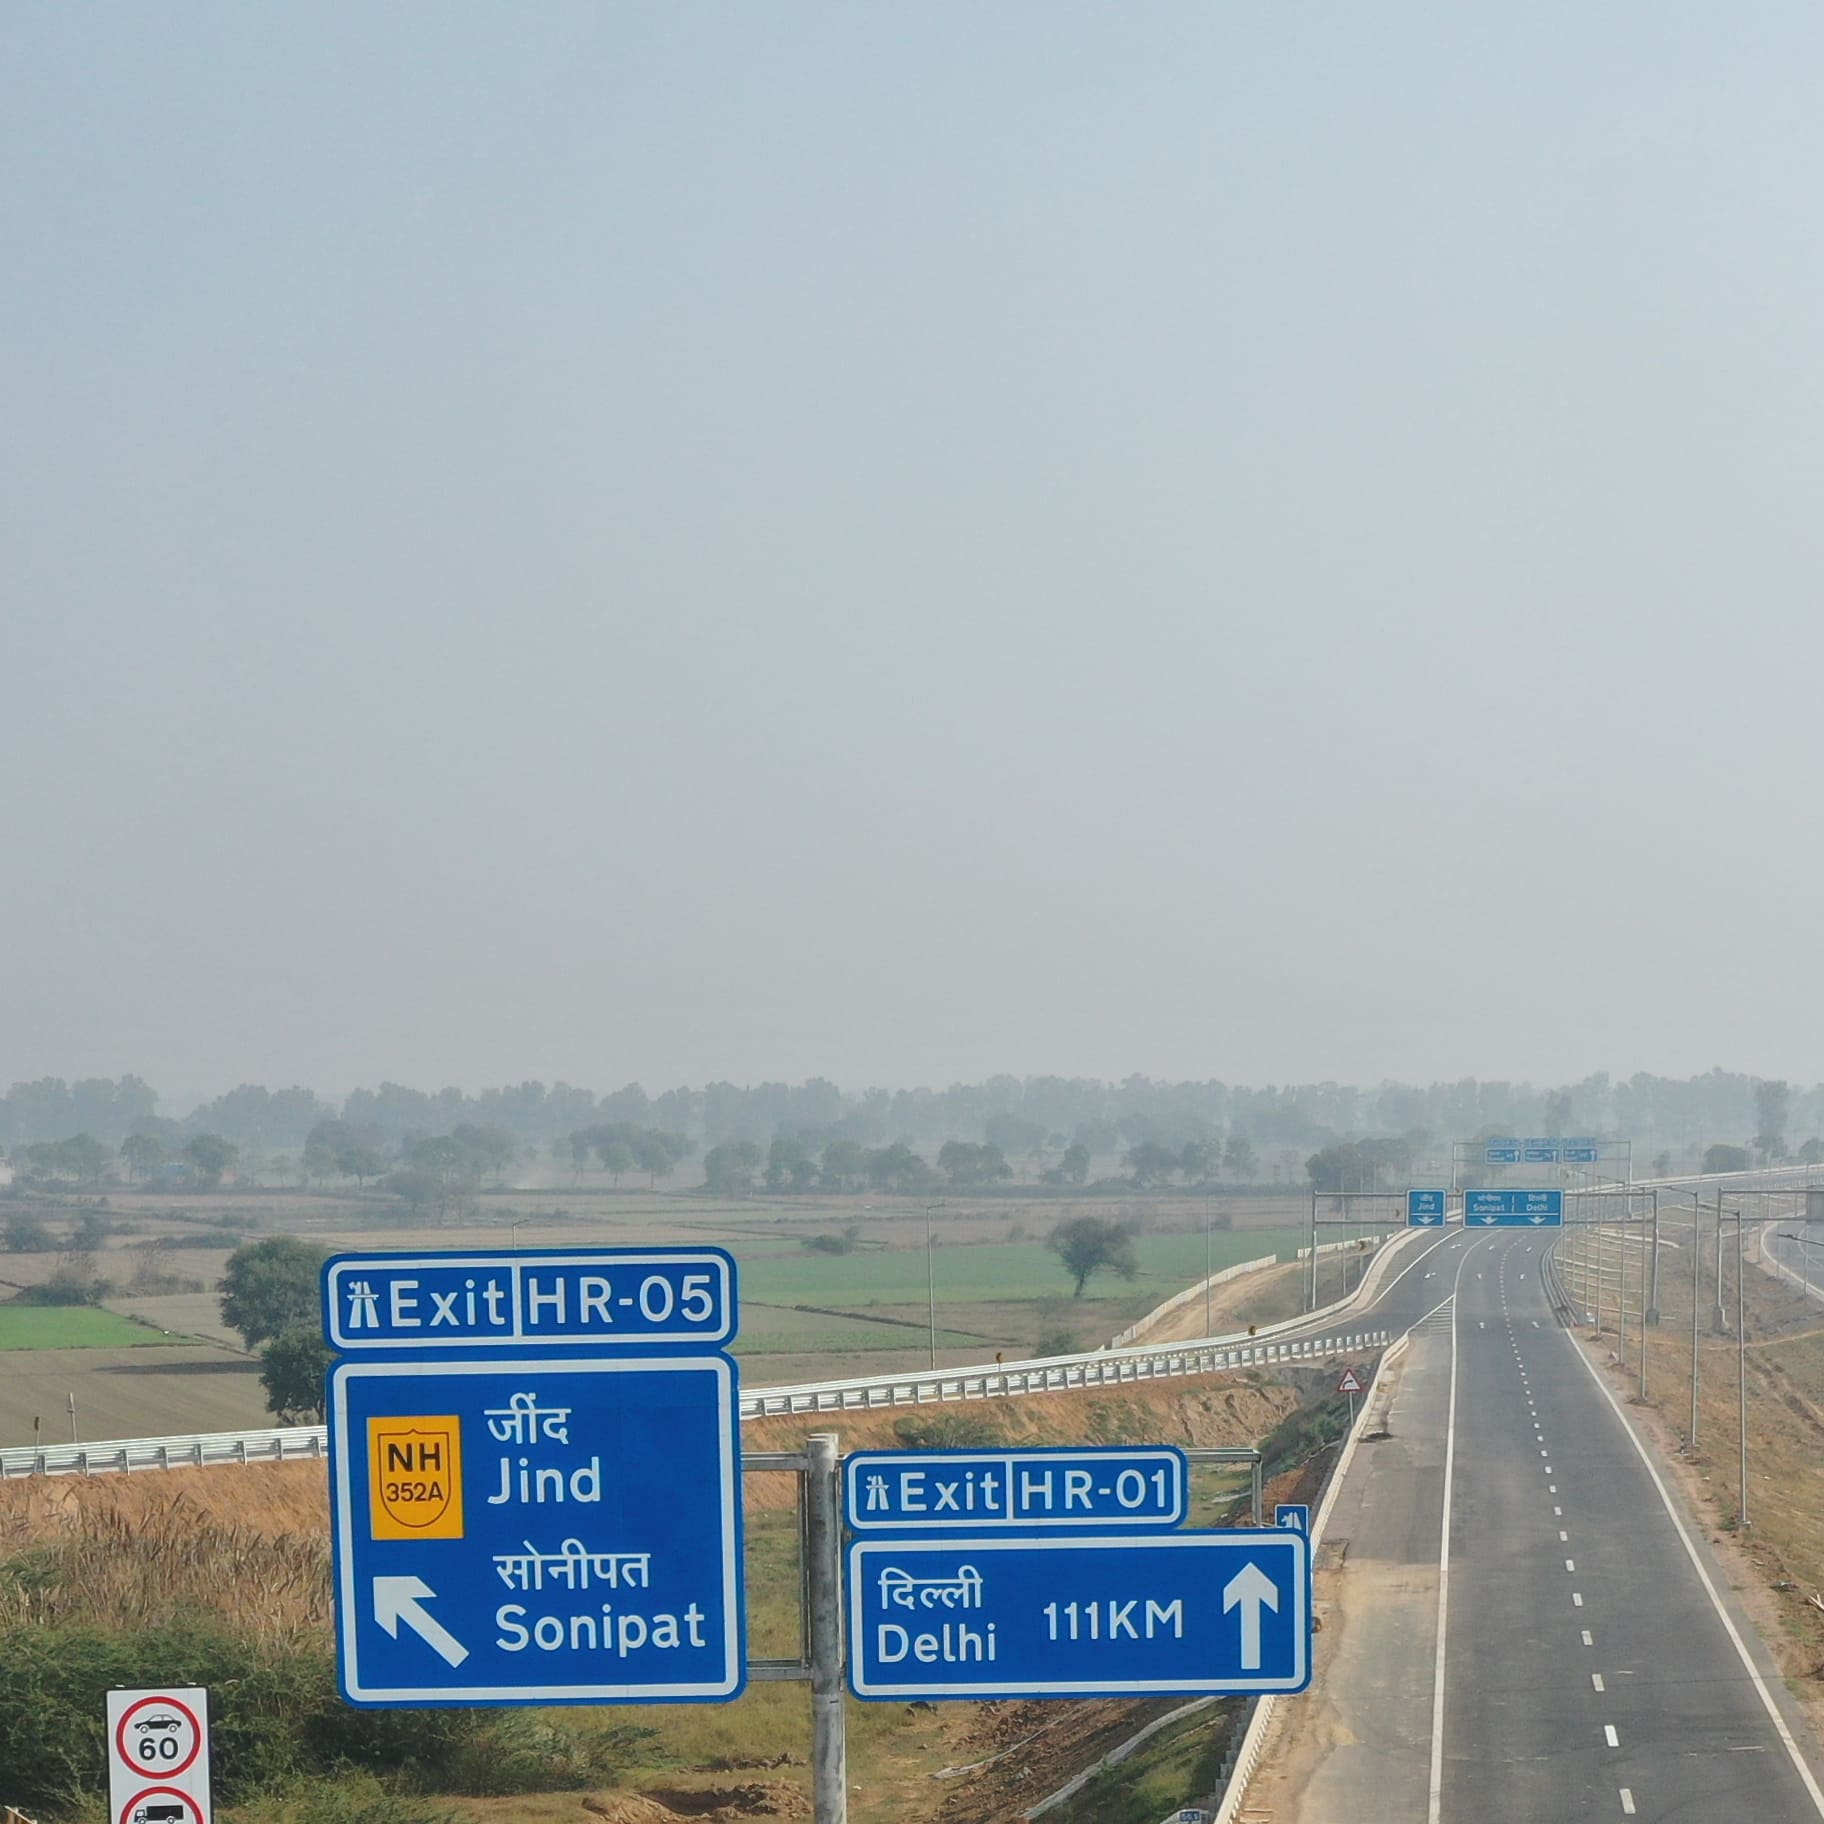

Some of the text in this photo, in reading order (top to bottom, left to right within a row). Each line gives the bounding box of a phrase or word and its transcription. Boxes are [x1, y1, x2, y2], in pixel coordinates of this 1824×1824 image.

[1418, 1202, 1435, 1211] Jind
[1526, 1203, 1548, 1212] Delhi
[390, 1272, 713, 1327] Exit HR-05
[484, 1393, 572, 1445] जींद
[388, 1442, 441, 1472] NH
[386, 1481, 443, 1502] 352A
[487, 1456, 601, 1505] Jind
[900, 1468, 1168, 1513] Exit HR-01
[493, 1538, 651, 1590] सोनीपत
[878, 1565, 984, 1610] दिल्ली
[495, 1602, 706, 1658] Sonipat
[878, 1618, 996, 1663] Delhi
[1043, 1599, 1182, 1640] 111KM
[138, 1737, 179, 1761] 60
